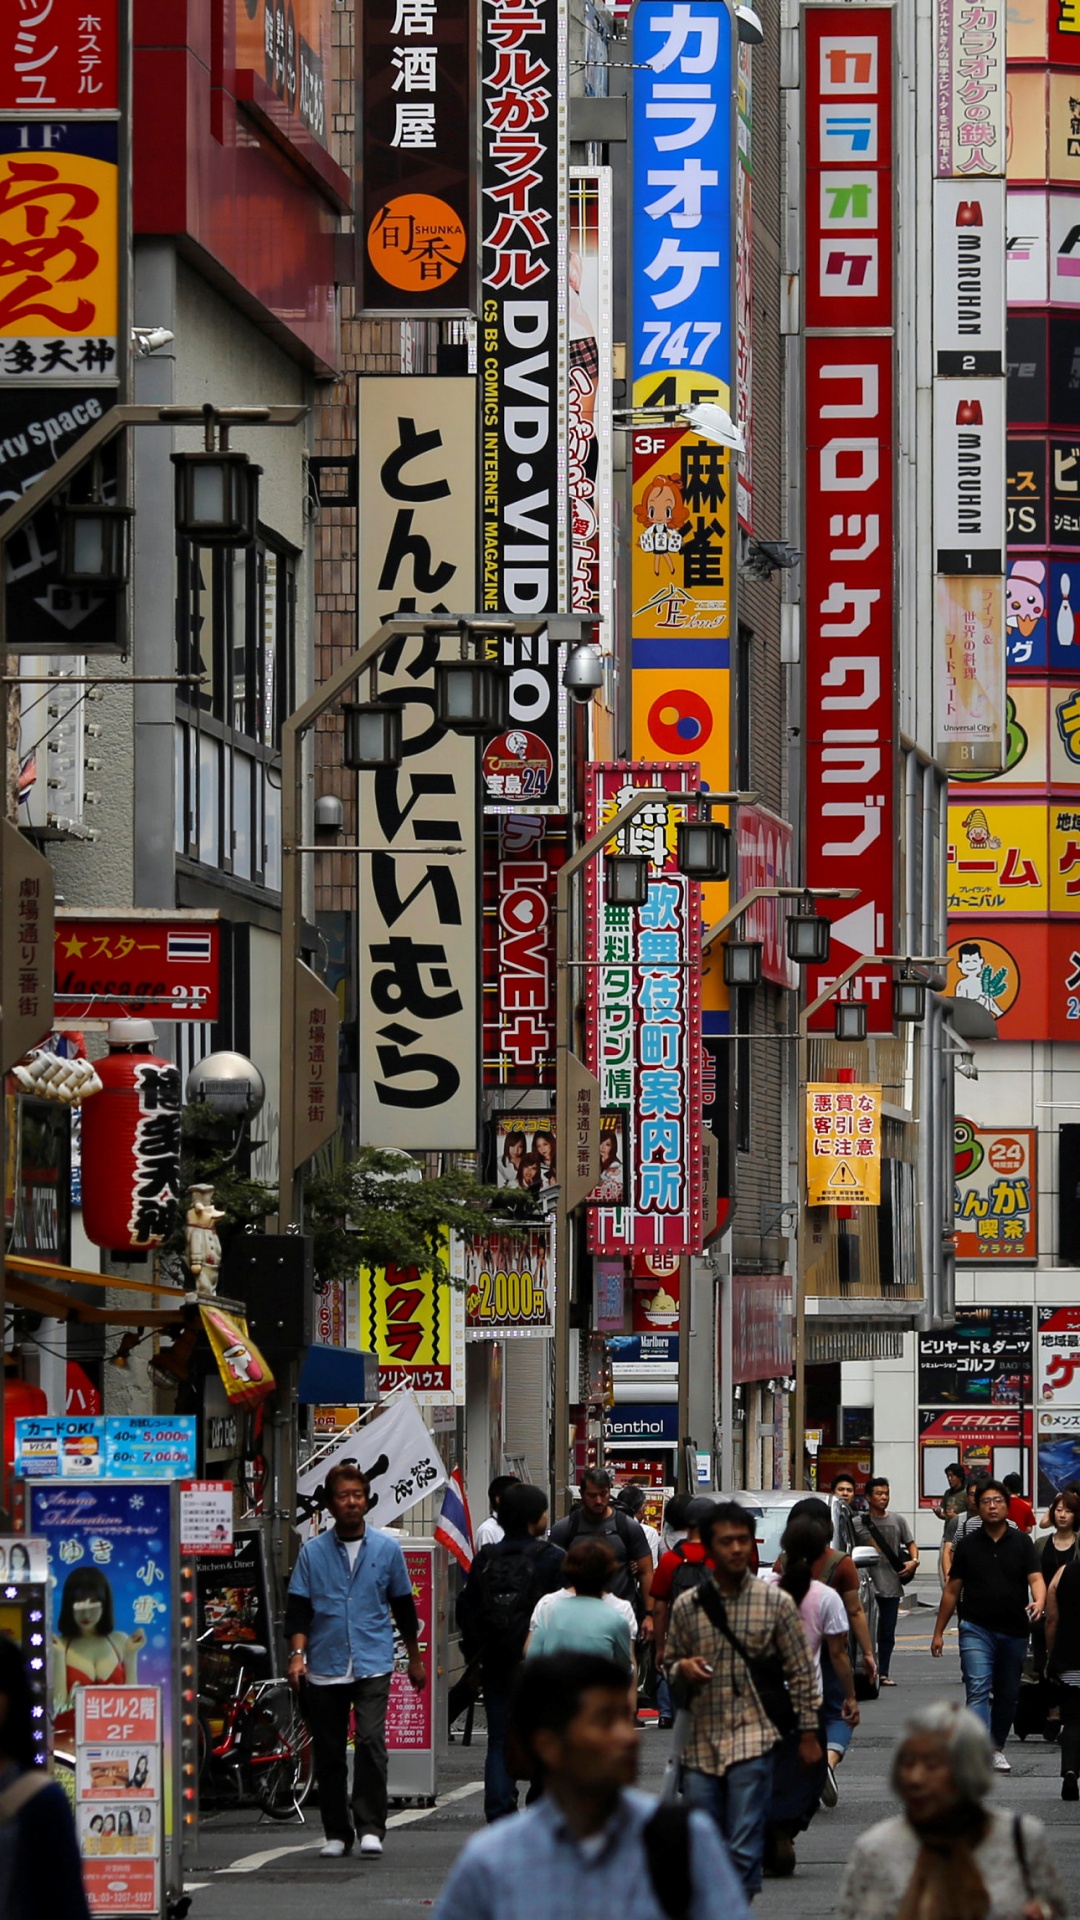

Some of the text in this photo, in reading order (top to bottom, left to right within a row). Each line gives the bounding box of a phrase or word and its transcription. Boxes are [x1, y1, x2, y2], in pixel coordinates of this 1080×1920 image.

[77, 15, 103, 94] ホステル
[389, 0, 438, 148] 居酒屋
[957, 7, 998, 172] カラオケの鉄人
[17, 124, 68, 149] 1F
[483, 0, 552, 290] テルがライバル
[643, 4, 721, 310] カラオケ
[825, 49, 873, 286] カラオケ
[371, 206, 461, 281] 旬香
[415, 225, 462, 235] SHUNKA
[957, 235, 982, 335] MARUHAN
[484, 300, 499, 323] CS
[0, 339, 115, 374] 多天神
[484, 331, 499, 351] BS
[639, 322, 721, 366] 747
[962, 355, 976, 370] 2
[484, 358, 499, 426] COMICS
[26, 397, 103, 446] Space
[634, 435, 665, 456] 3F
[484, 431, 499, 516] INTERNET
[957, 433, 982, 533] MARUHAN
[678, 440, 727, 589] 麻雀
[484, 522, 499, 611] MAGAZINE
[964, 554, 973, 569] 1
[818, 365, 886, 857] コロッケクラブ
[963, 610, 977, 680] 世界の料理
[1006, 640, 1033, 664] グ
[945, 634, 957, 716] フードコート
[943, 723, 991, 733] Universal City
[369, 416, 464, 1109] とんかつにいむら
[961, 746, 976, 760] B1
[947, 844, 1042, 888] ーム
[19, 877, 40, 1017] 劇場通り一番街
[171, 985, 211, 1010] 2F
[604, 905, 632, 1109] 無料タウン情
[638, 883, 683, 1210] 歌舞伎町案内所
[308, 1008, 327, 1122] 劇場通り一番街
[813, 1093, 875, 1112] 悪質な
[577, 1088, 591, 1177] 劇場通り一番街
[813, 1115, 873, 1135] 客引き
[813, 1137, 875, 1157] に注意
[991, 1143, 1021, 1161] 24
[954, 1179, 1029, 1218] んが
[978, 1218, 1025, 1239] 喫茶
[979, 1243, 1025, 1254] ケラケラ
[479, 1271, 544, 1318] 2,000円
[641, 1336, 669, 1347] Marlboro
[999, 1361, 1031, 1370] BAGS
[28, 1422, 94, 1435] カードOK!
[603, 1419, 664, 1433] menthol
[923, 1411, 935, 1423] 7F
[942, 1415, 1021, 1426] FACE
[142, 1431, 189, 1442] 5,000円
[197, 1562, 225, 1572] Kitchen
[234, 1560, 255, 1569] Diner
[86, 1696, 155, 1720] 当ビル2階
[107, 1724, 134, 1740] 2F
